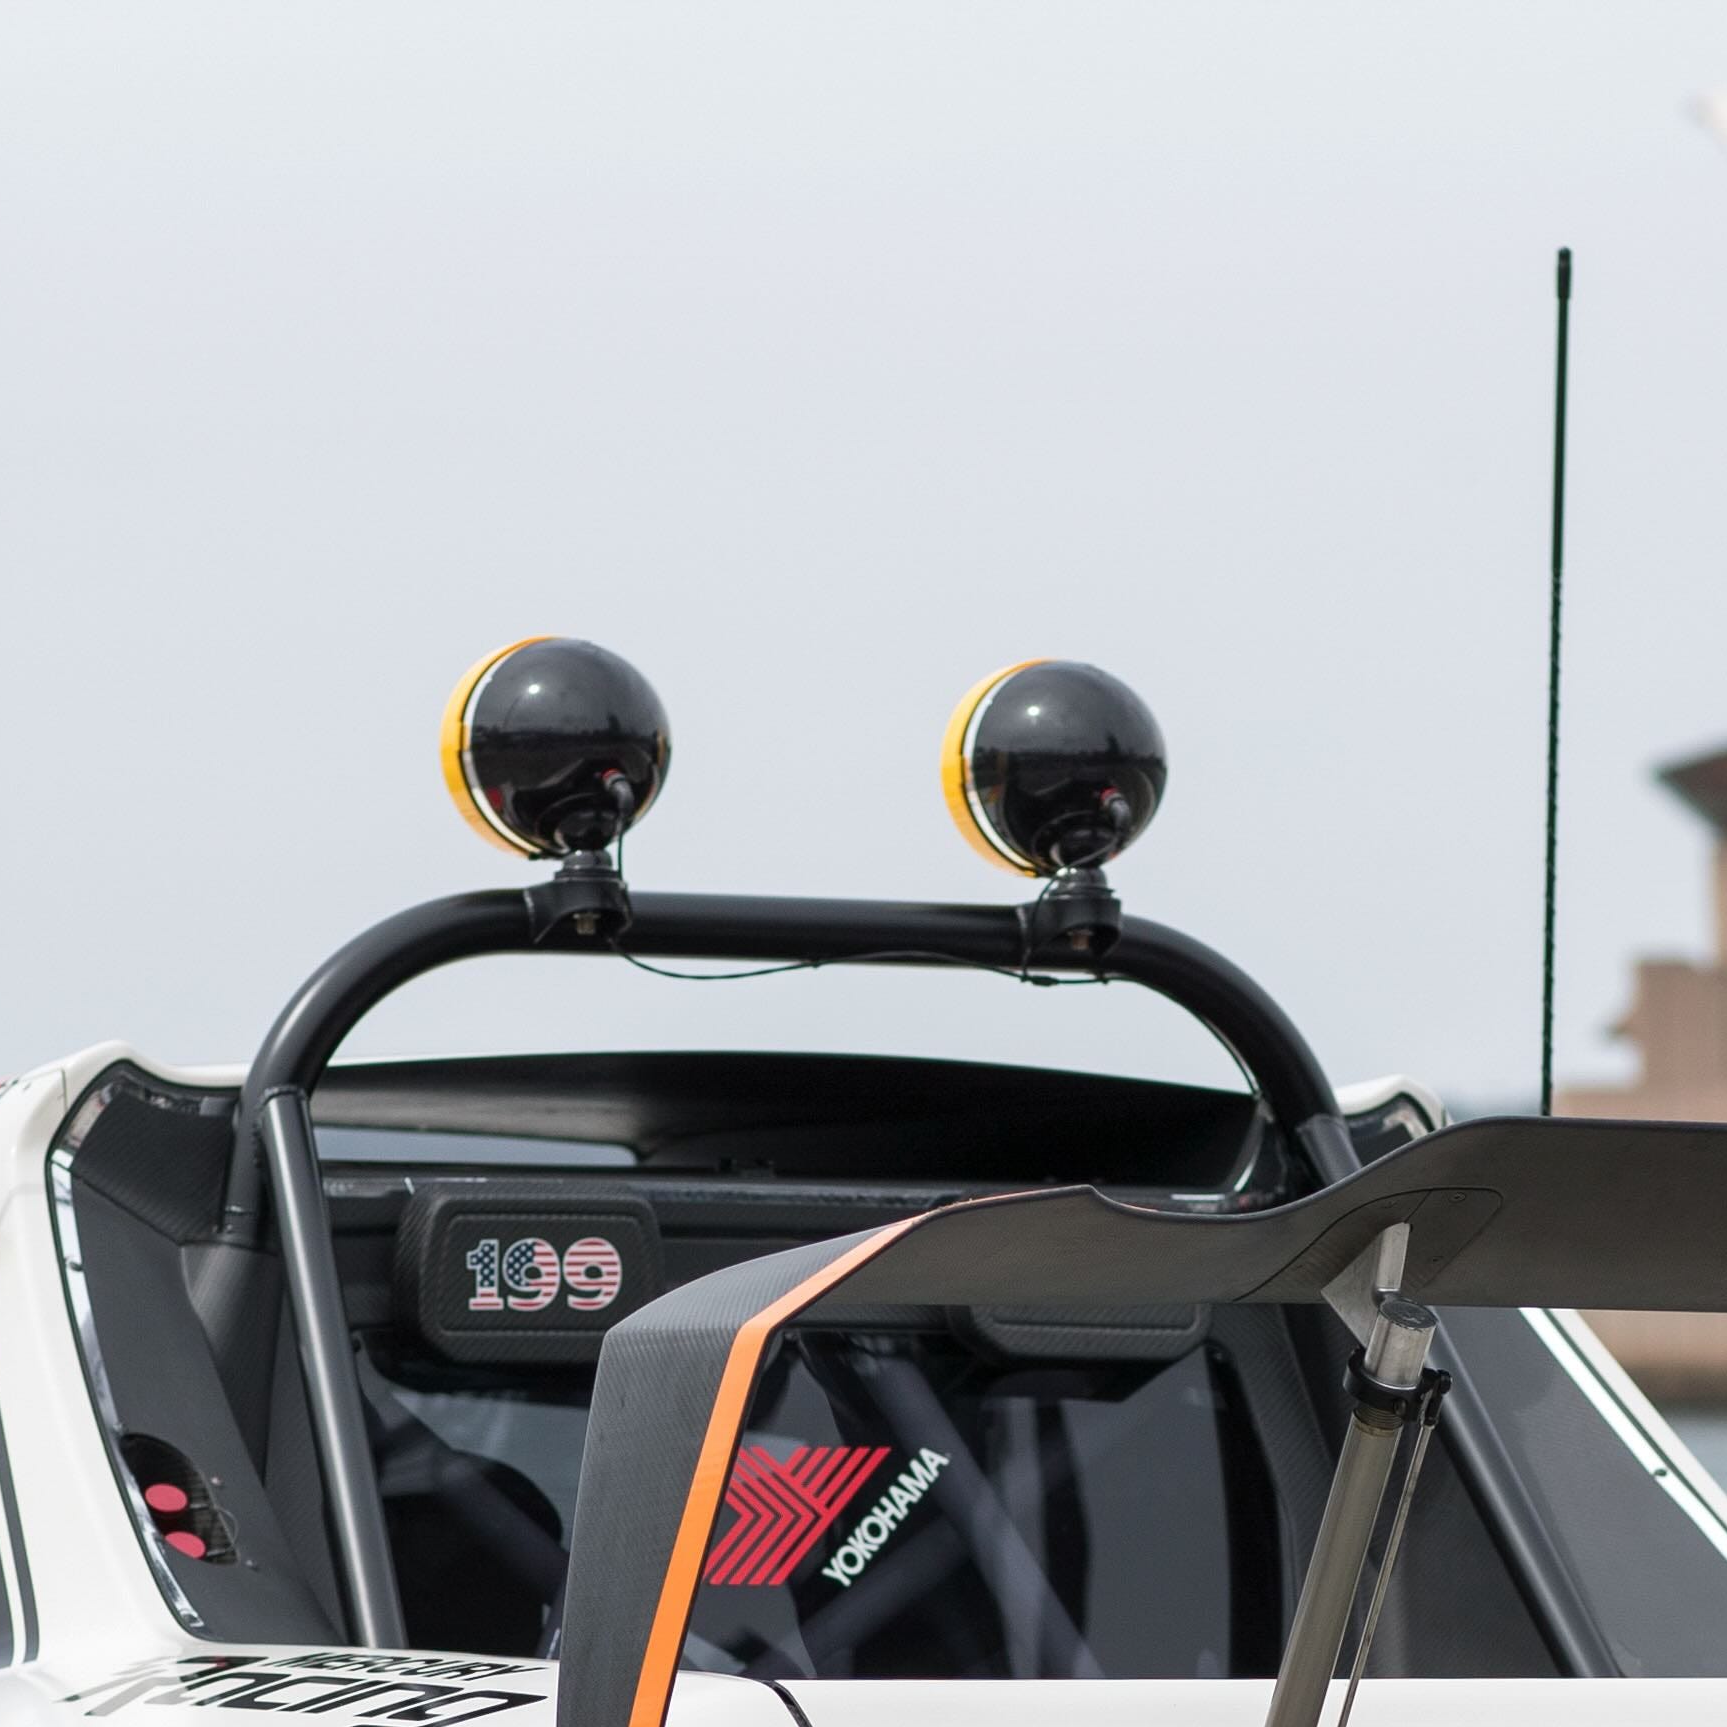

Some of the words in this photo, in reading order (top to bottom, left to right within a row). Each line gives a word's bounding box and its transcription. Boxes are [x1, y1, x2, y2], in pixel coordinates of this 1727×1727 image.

[466, 1237, 623, 1312] 199
[821, 1446, 949, 1588] YOKOHAMA
[267, 1652, 552, 1681] MERCURY
